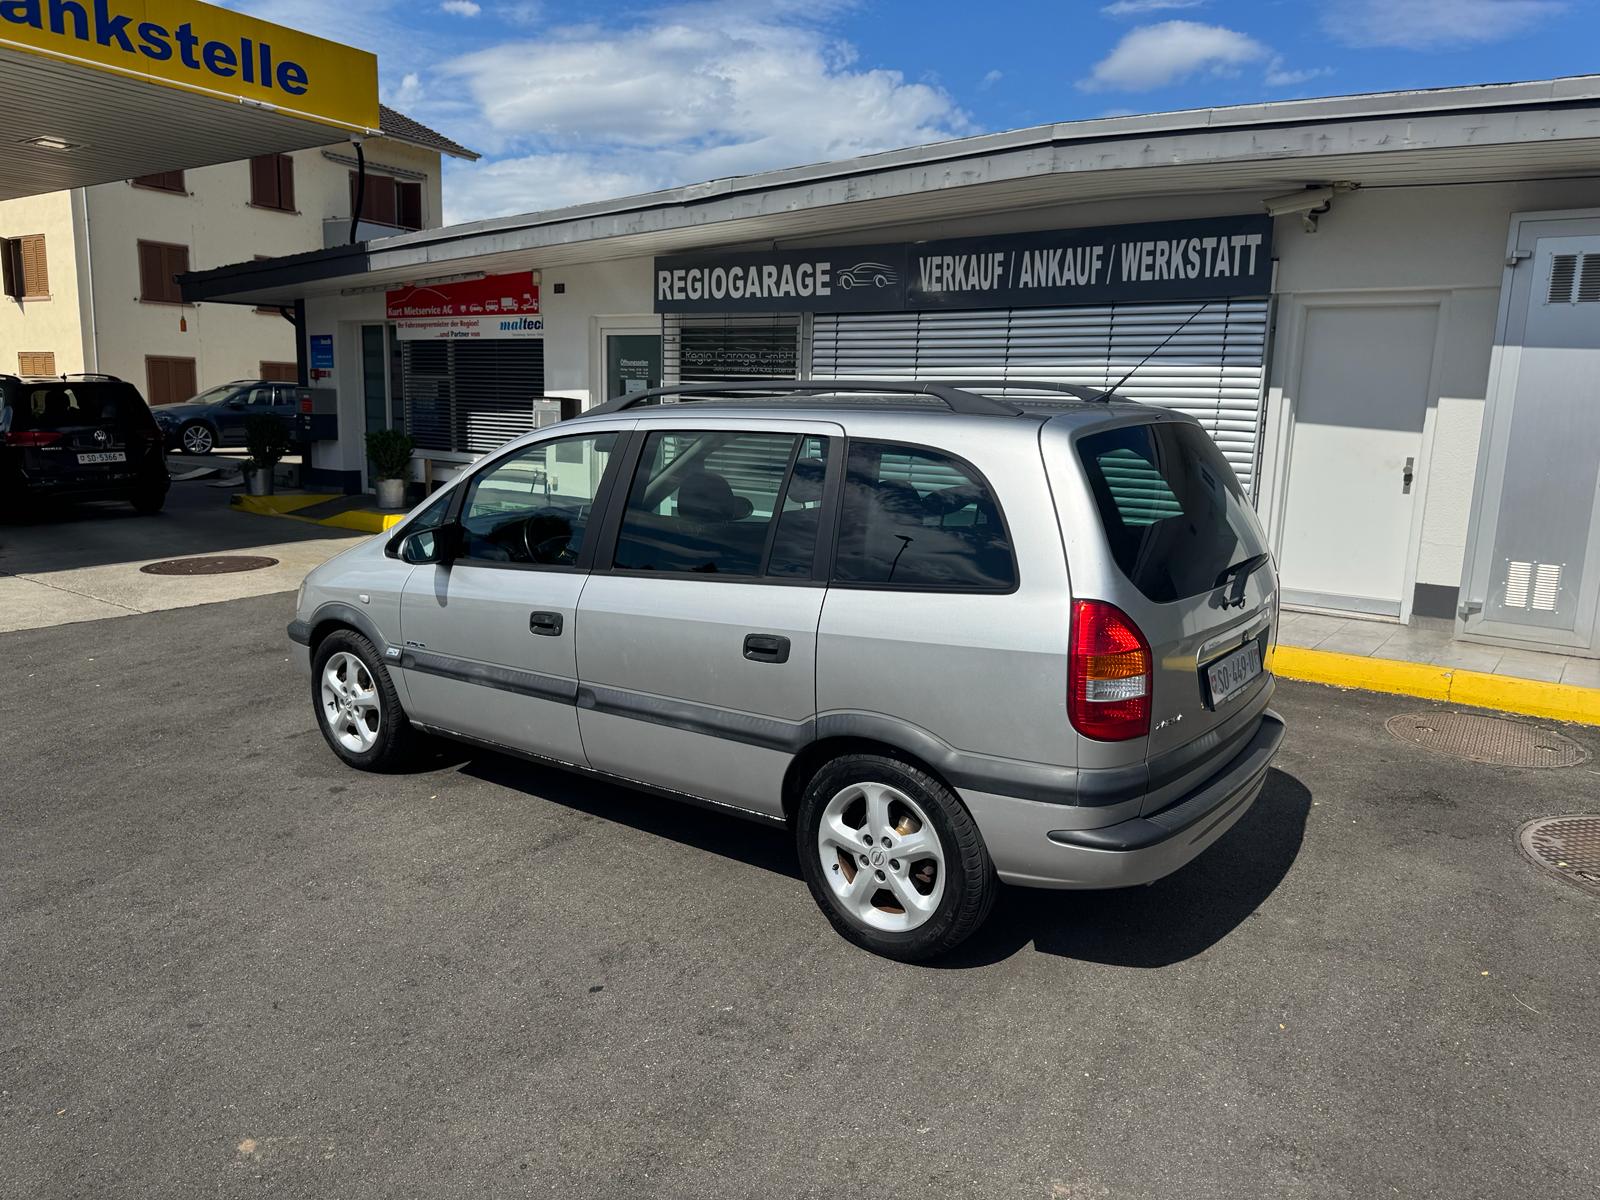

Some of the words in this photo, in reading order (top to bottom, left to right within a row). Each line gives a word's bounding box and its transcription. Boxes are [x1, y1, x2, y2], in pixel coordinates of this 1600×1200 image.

[919, 251, 1004, 293] VERKAUF
[1008, 251, 1016, 289] /
[1019, 246, 1104, 288] ANKAUF
[1106, 244, 1116, 285] /
[1121, 233, 1262, 282] WERKSTATT
[658, 262, 831, 301] REGIOGARAGE
[388, 307, 402, 316] Kurt
[403, 305, 441, 316] Mietservice
[442, 305, 453, 314] AG
[451, 320, 459, 328] der
[685, 347, 713, 366] Regio
[715, 347, 757, 366] Garage
[760, 347, 794, 364] GmbH
